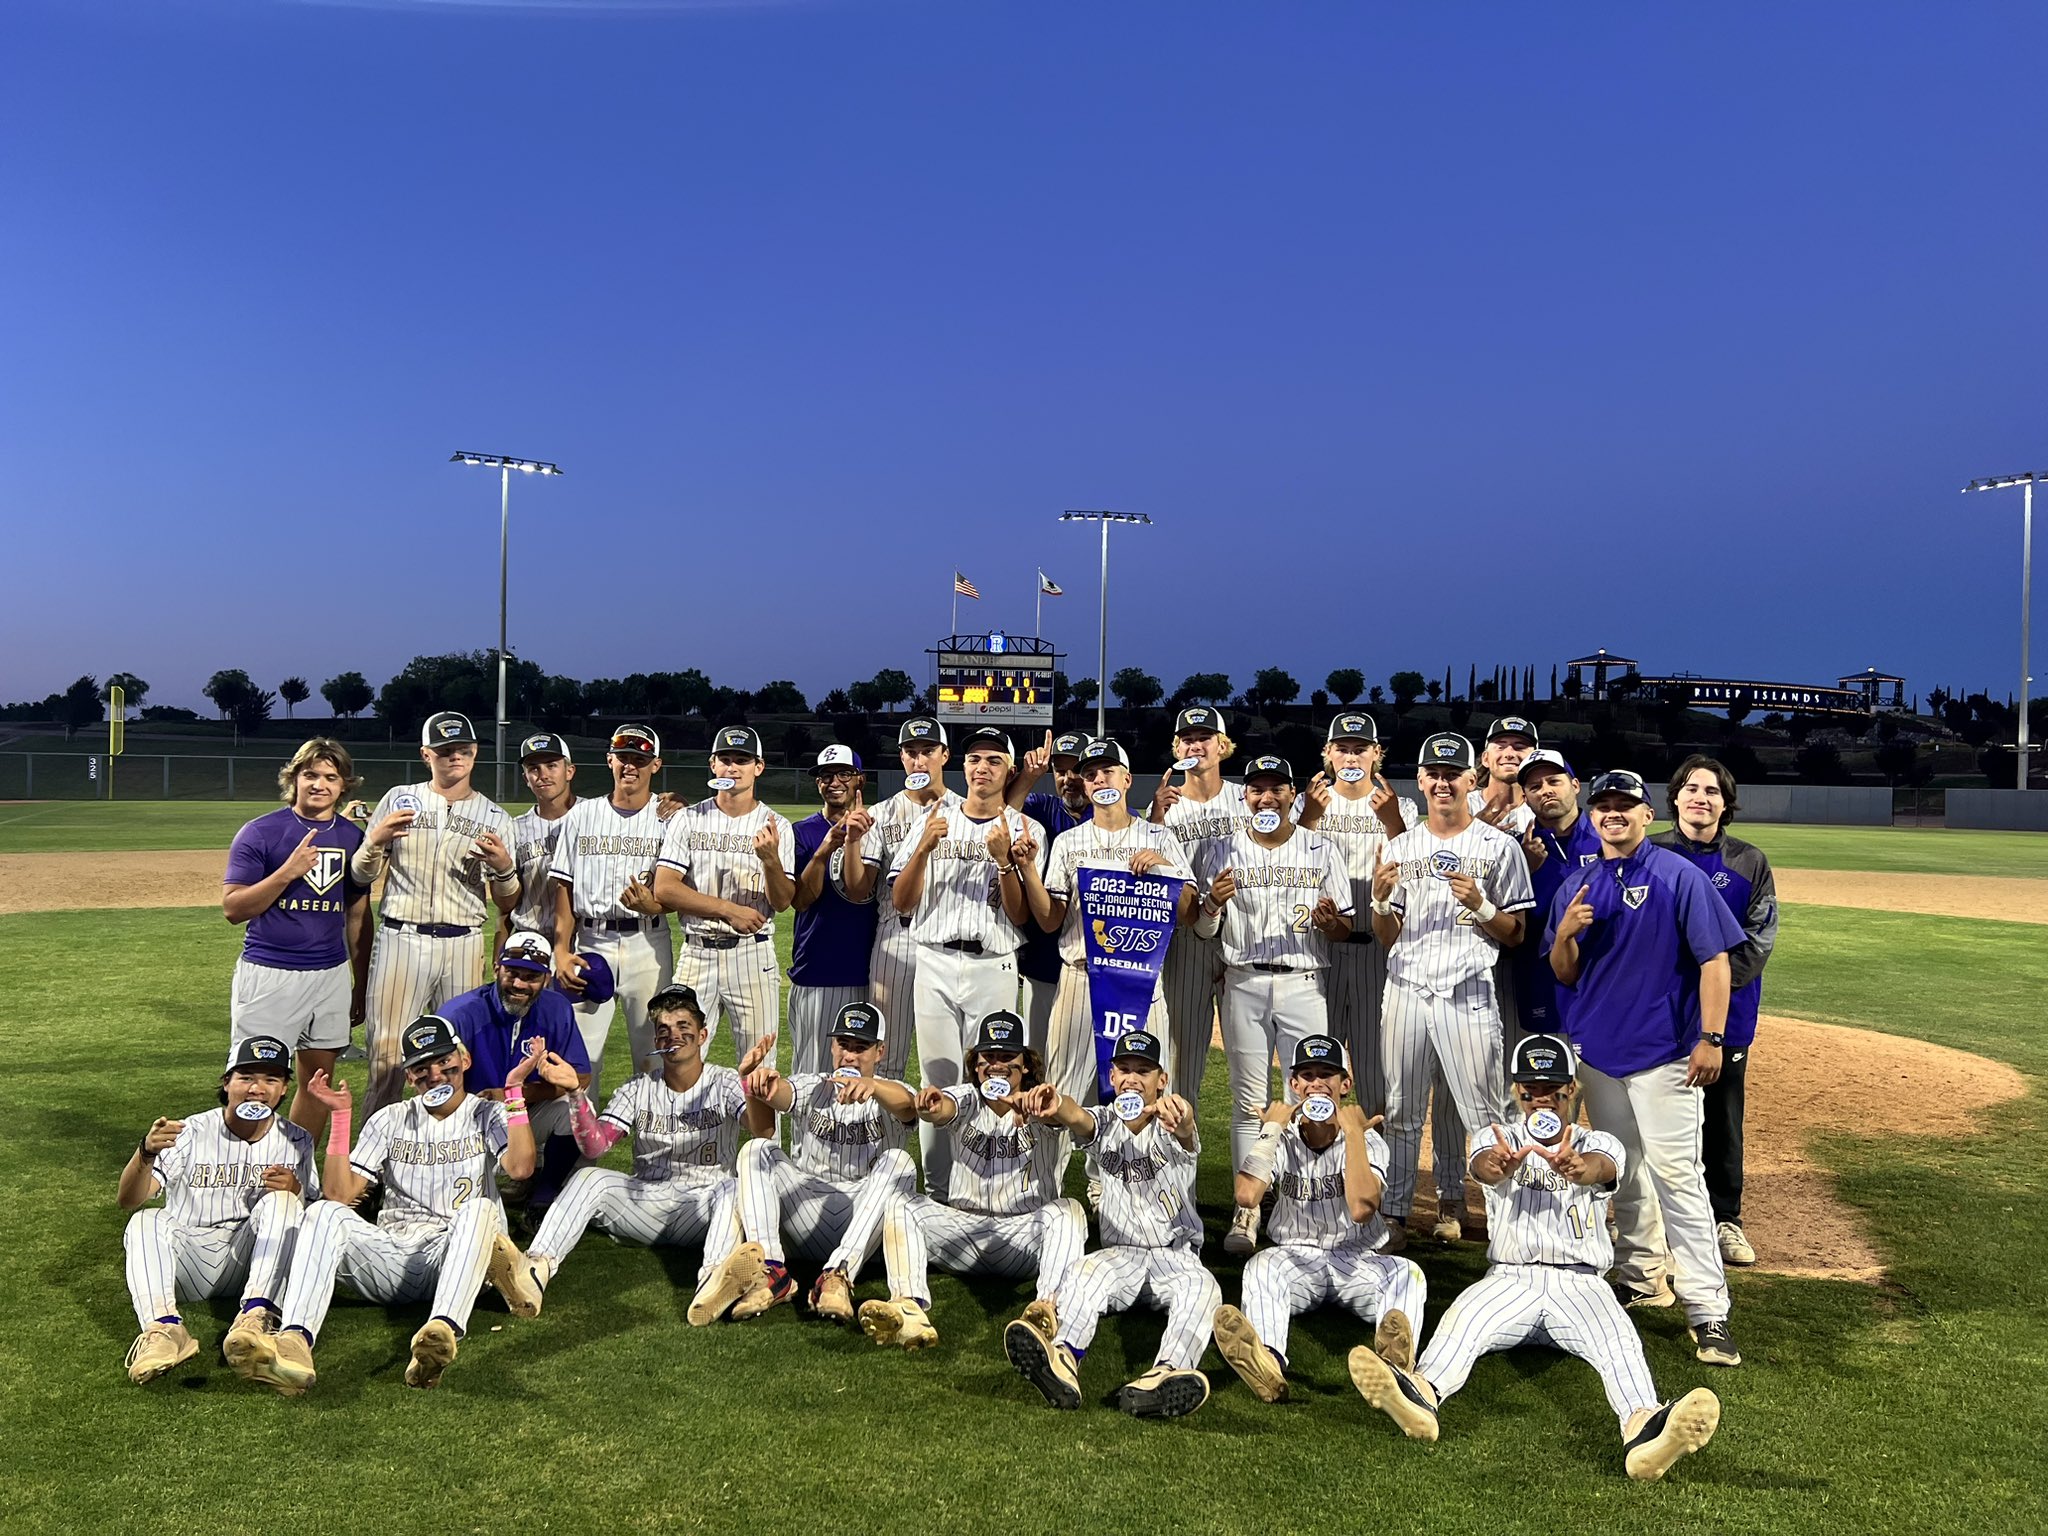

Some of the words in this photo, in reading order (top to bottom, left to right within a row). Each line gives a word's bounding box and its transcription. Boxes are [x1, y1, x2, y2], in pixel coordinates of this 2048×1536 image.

[1694, 687, 1741, 699] RIVER
[1753, 690, 1820, 703] ISLANDS
[988, 705, 1011, 713] pepsi
[1316, 813, 1386, 835] RADSHA
[1437, 861, 1458, 872] SJS
[1090, 877, 1168, 899] 2023-2024
[1083, 892, 1140, 906] SAC-JOAQUIN
[1141, 898, 1173, 911] SECTION
[1087, 903, 1170, 923] CHAMPIONS
[1103, 925, 1162, 952] SJS
[1093, 956, 1154, 972] BASEBALL
[1102, 1011, 1137, 1038] D5
[1122, 1101, 1140, 1111] SJS
[1310, 1105, 1331, 1114] SJS
[1535, 1120, 1557, 1132] SJS
[961, 1125, 1038, 1160] BRADSHAW
[701, 1141, 718, 1166] 8
[1158, 1183, 1183, 1220] 11
[1567, 1204, 1596, 1239] 14
